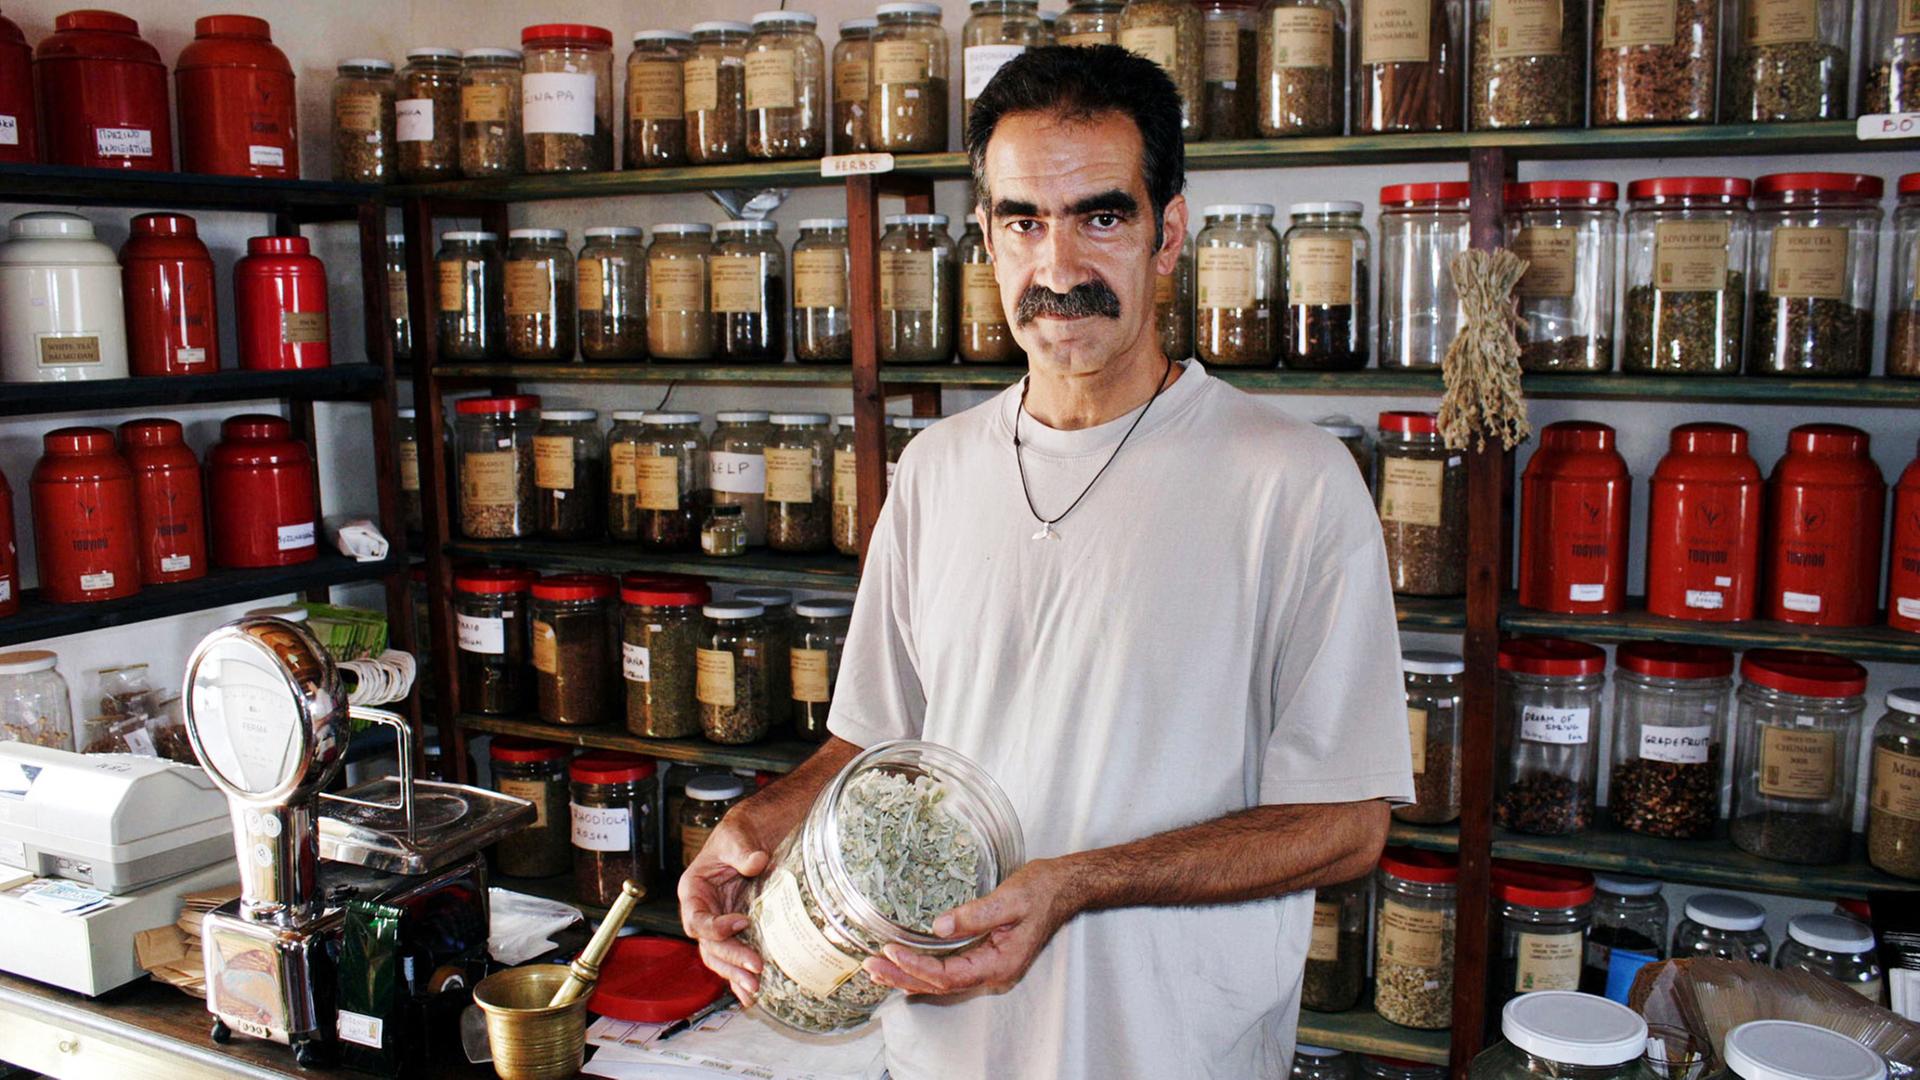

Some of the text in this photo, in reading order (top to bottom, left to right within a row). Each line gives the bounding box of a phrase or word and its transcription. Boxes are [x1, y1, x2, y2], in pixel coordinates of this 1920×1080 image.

[1662, 234, 1687, 243] LOVE
[1814, 237, 1832, 245] TEA
[711, 461, 750, 475] KELP
[1525, 712, 1575, 723] DREAM OF
[1644, 734, 1709, 748] GRAPEFRUIT
